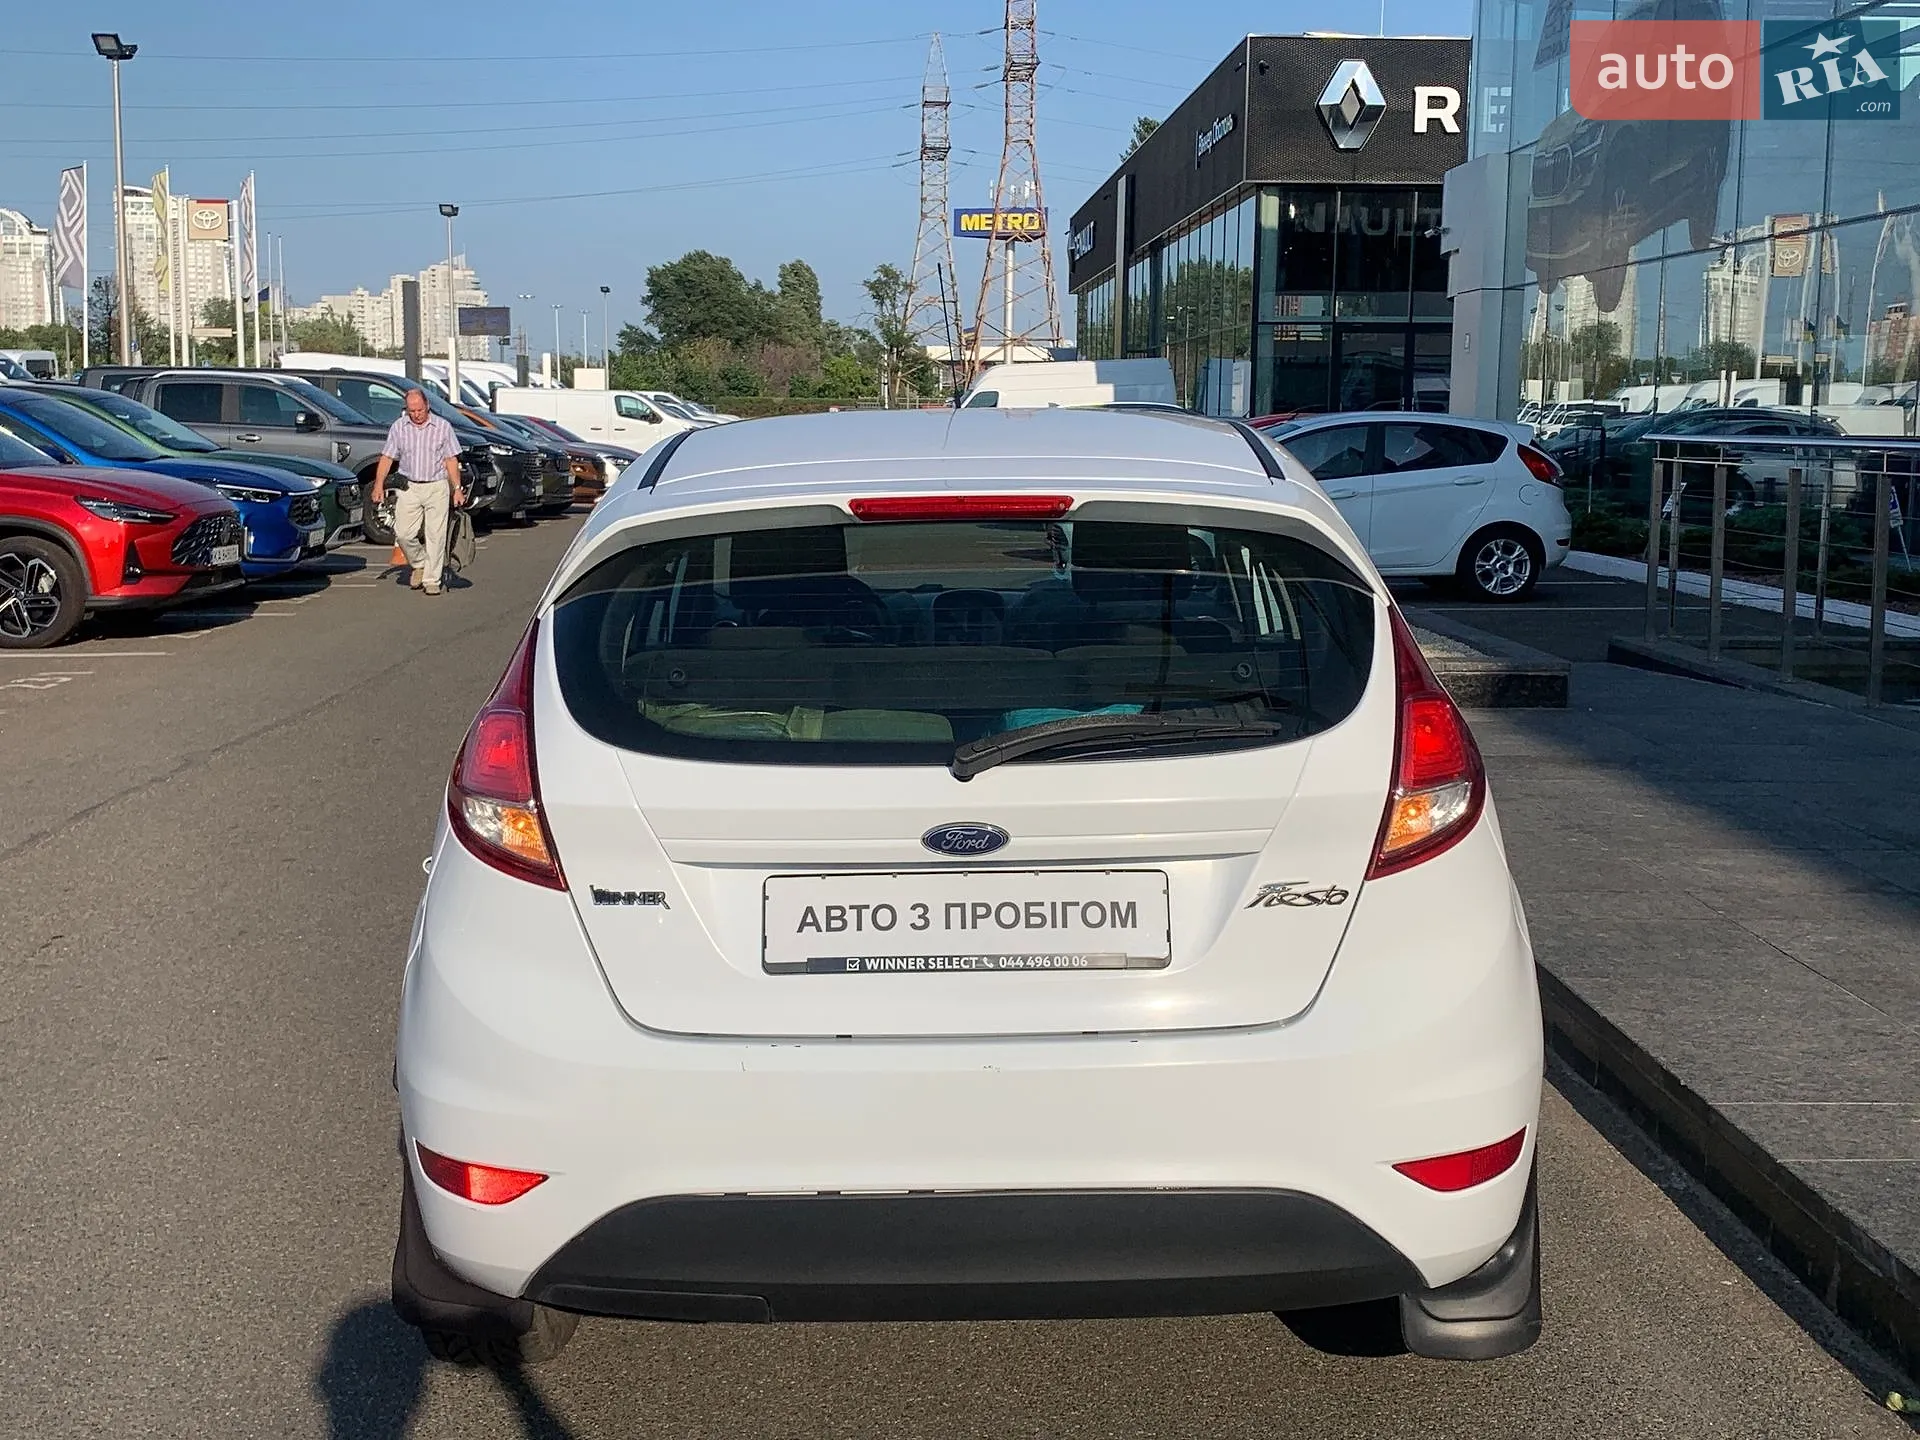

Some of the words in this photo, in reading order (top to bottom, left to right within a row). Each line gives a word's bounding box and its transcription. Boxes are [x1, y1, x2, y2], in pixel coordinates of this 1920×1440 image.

[960, 212, 1041, 232] METRO
[941, 830, 990, 850] Ford
[589, 884, 671, 910] WINNER
[1243, 880, 1349, 910] Fiesta
[796, 903, 898, 933] АВТО
[944, 900, 1137, 931] ПРОБІГОМ
[865, 957, 925, 970] WINNER
[928, 956, 979, 969] SELECT
[999, 955, 1024, 968] 044
[1026, 955, 1051, 968] 496
[1053, 955, 1070, 968] 00
[1072, 954, 1089, 967] 06
